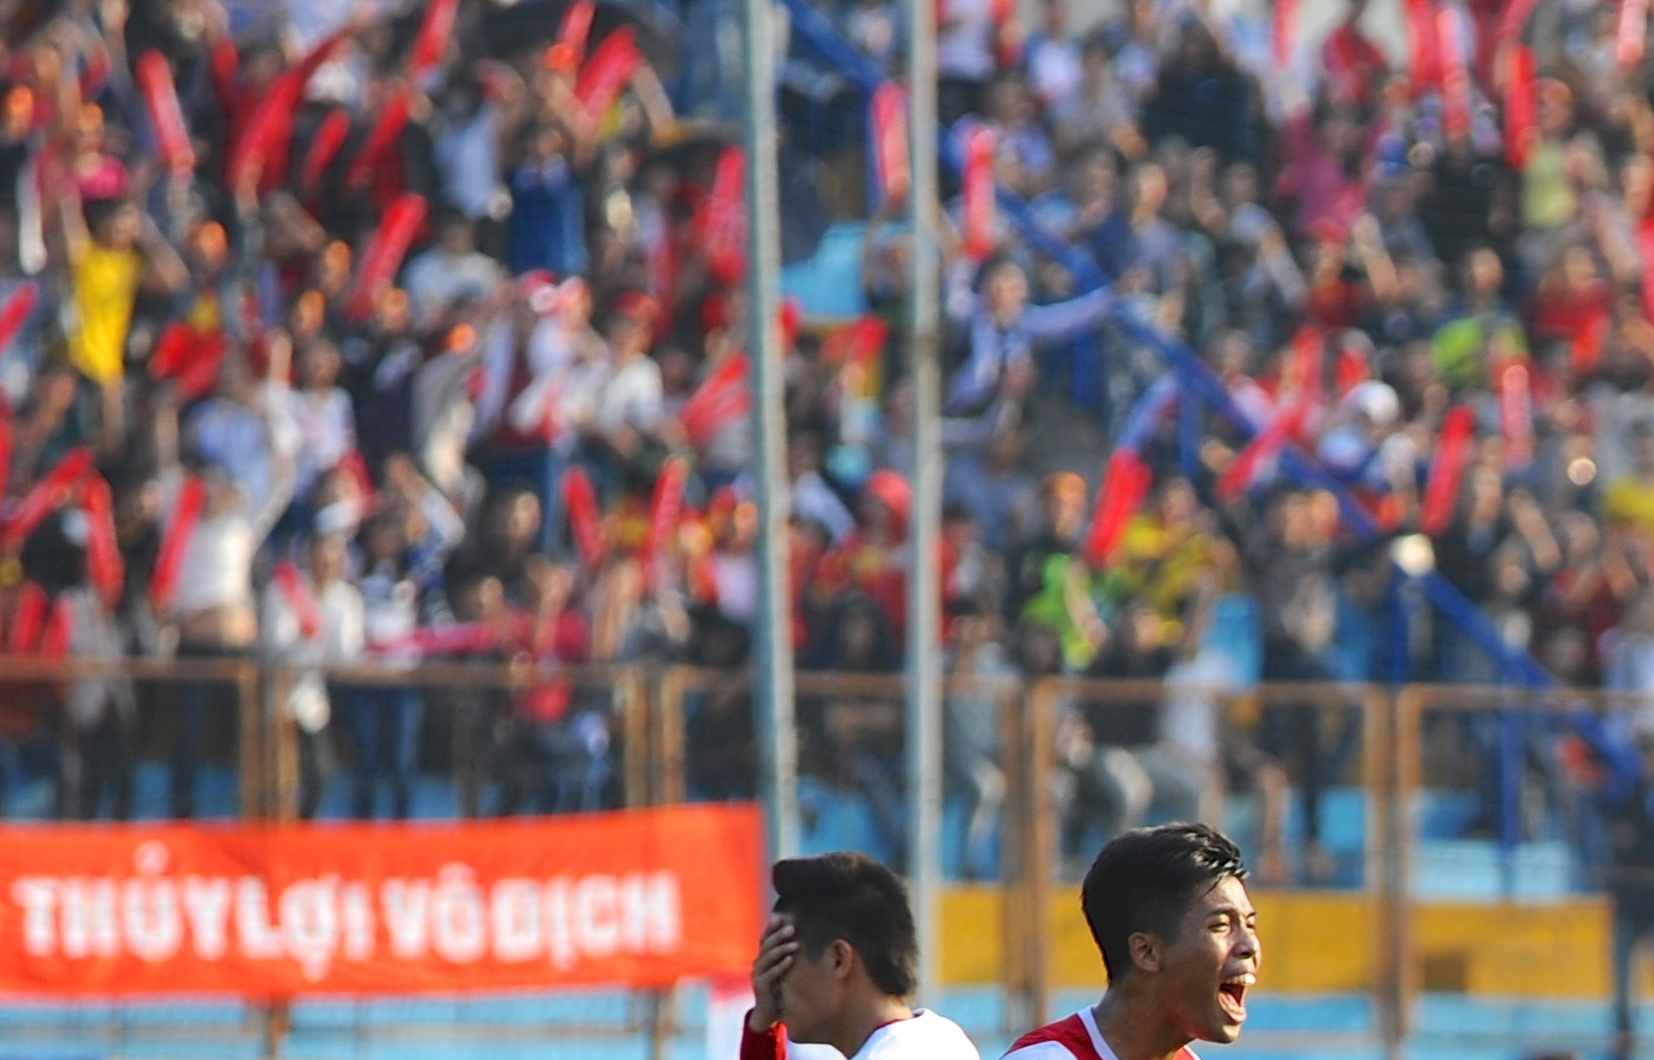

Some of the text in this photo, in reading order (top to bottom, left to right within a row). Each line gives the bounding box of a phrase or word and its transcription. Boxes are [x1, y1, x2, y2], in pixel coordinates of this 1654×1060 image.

[13, 842, 228, 962] THỦY
[236, 875, 373, 980] LỢI
[381, 862, 487, 964] VÔ
